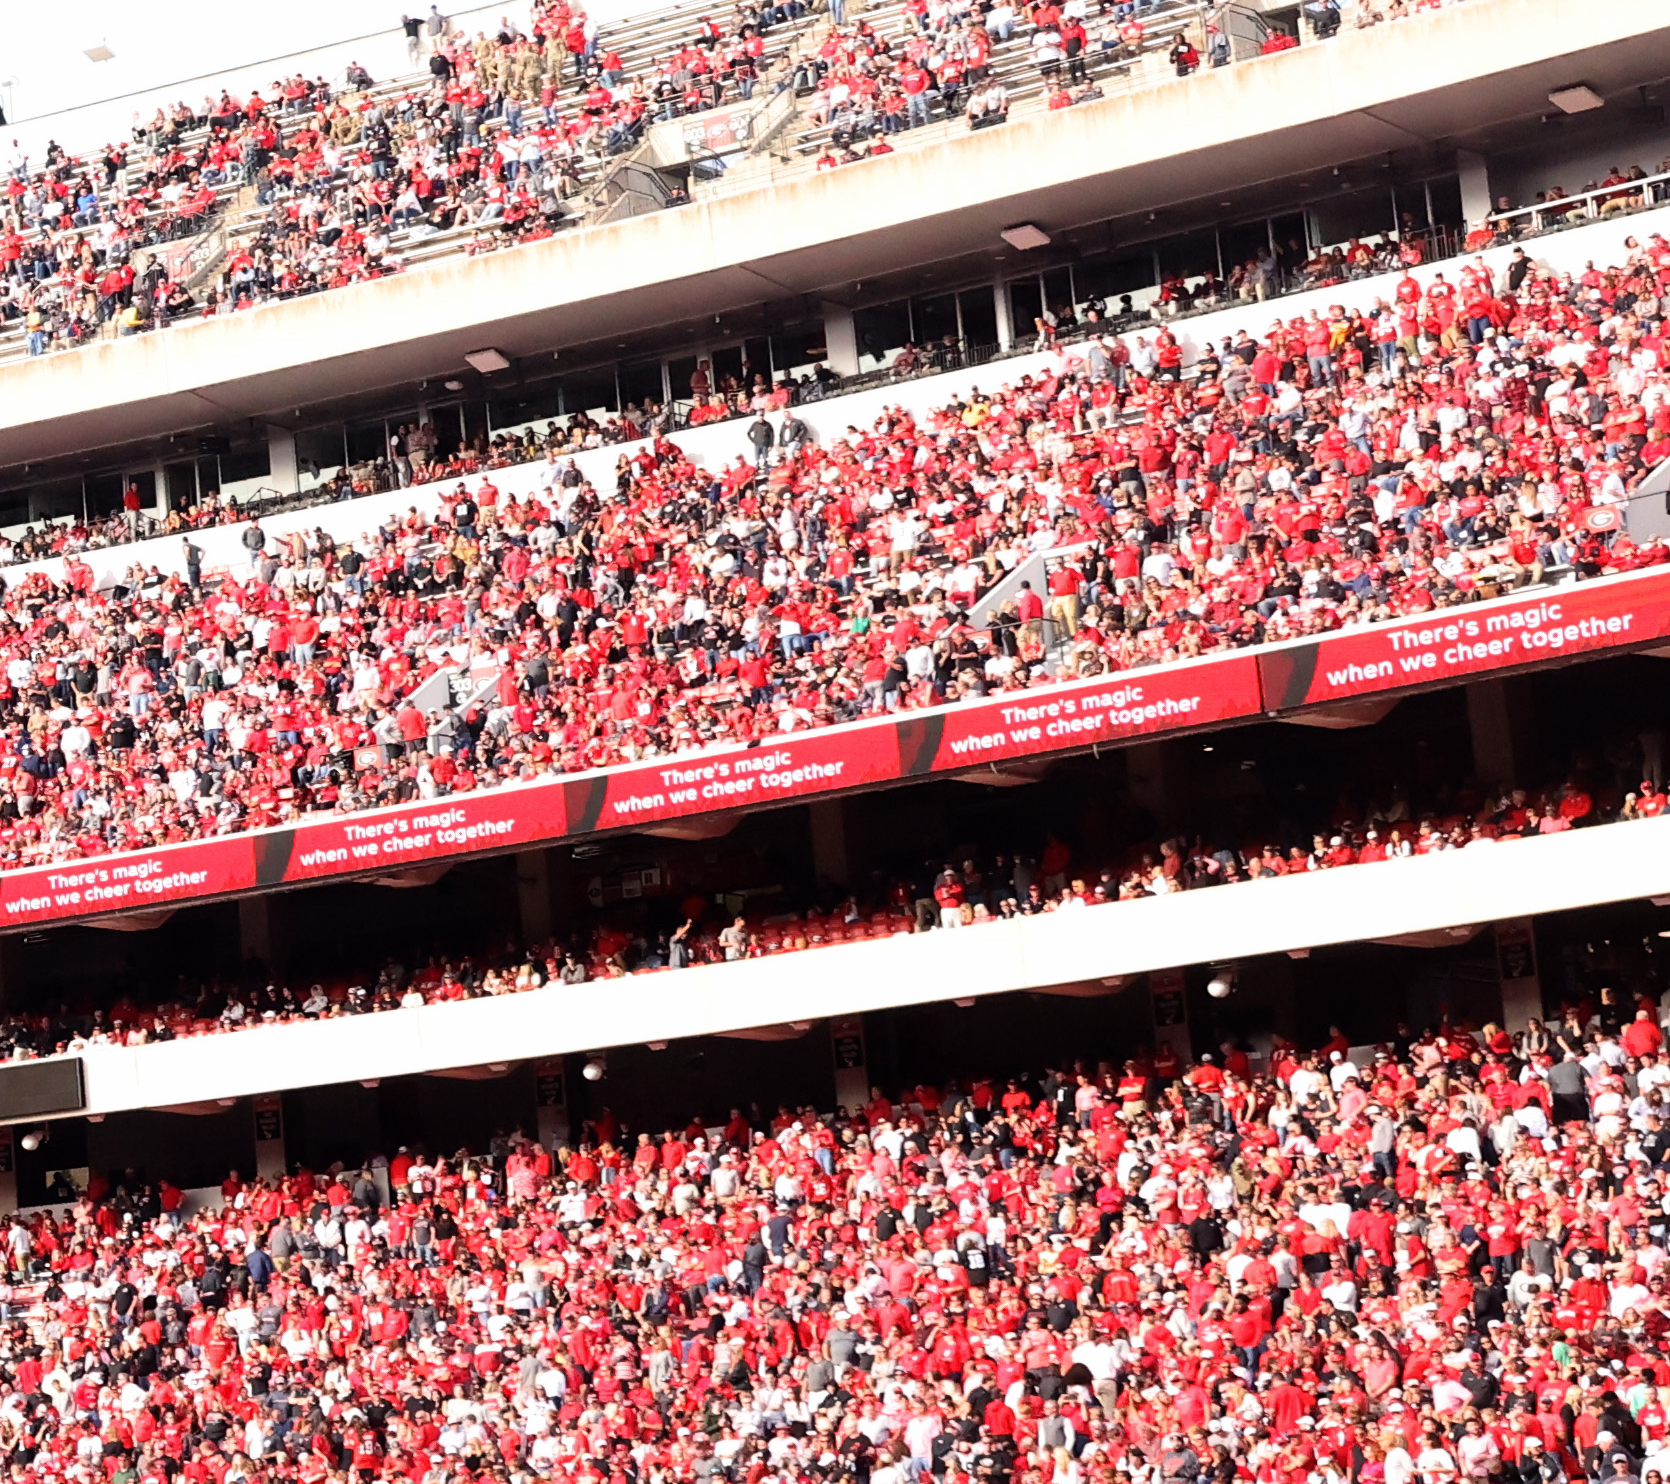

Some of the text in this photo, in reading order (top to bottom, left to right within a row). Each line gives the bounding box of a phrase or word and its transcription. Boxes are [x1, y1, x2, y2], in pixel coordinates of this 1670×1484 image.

[1388, 603, 1562, 649] There's magic
[1326, 614, 1633, 687] when we cheer together
[950, 694, 1200, 755] when we cheer together
[1001, 685, 1144, 725] There's magic
[614, 760, 844, 814] when we cheer together
[661, 750, 792, 787] There's magic
[300, 818, 515, 867] when we cheer together
[344, 807, 466, 841] There's magic
[6, 871, 207, 914] when we cheer together
[48, 860, 163, 890] There's magic
